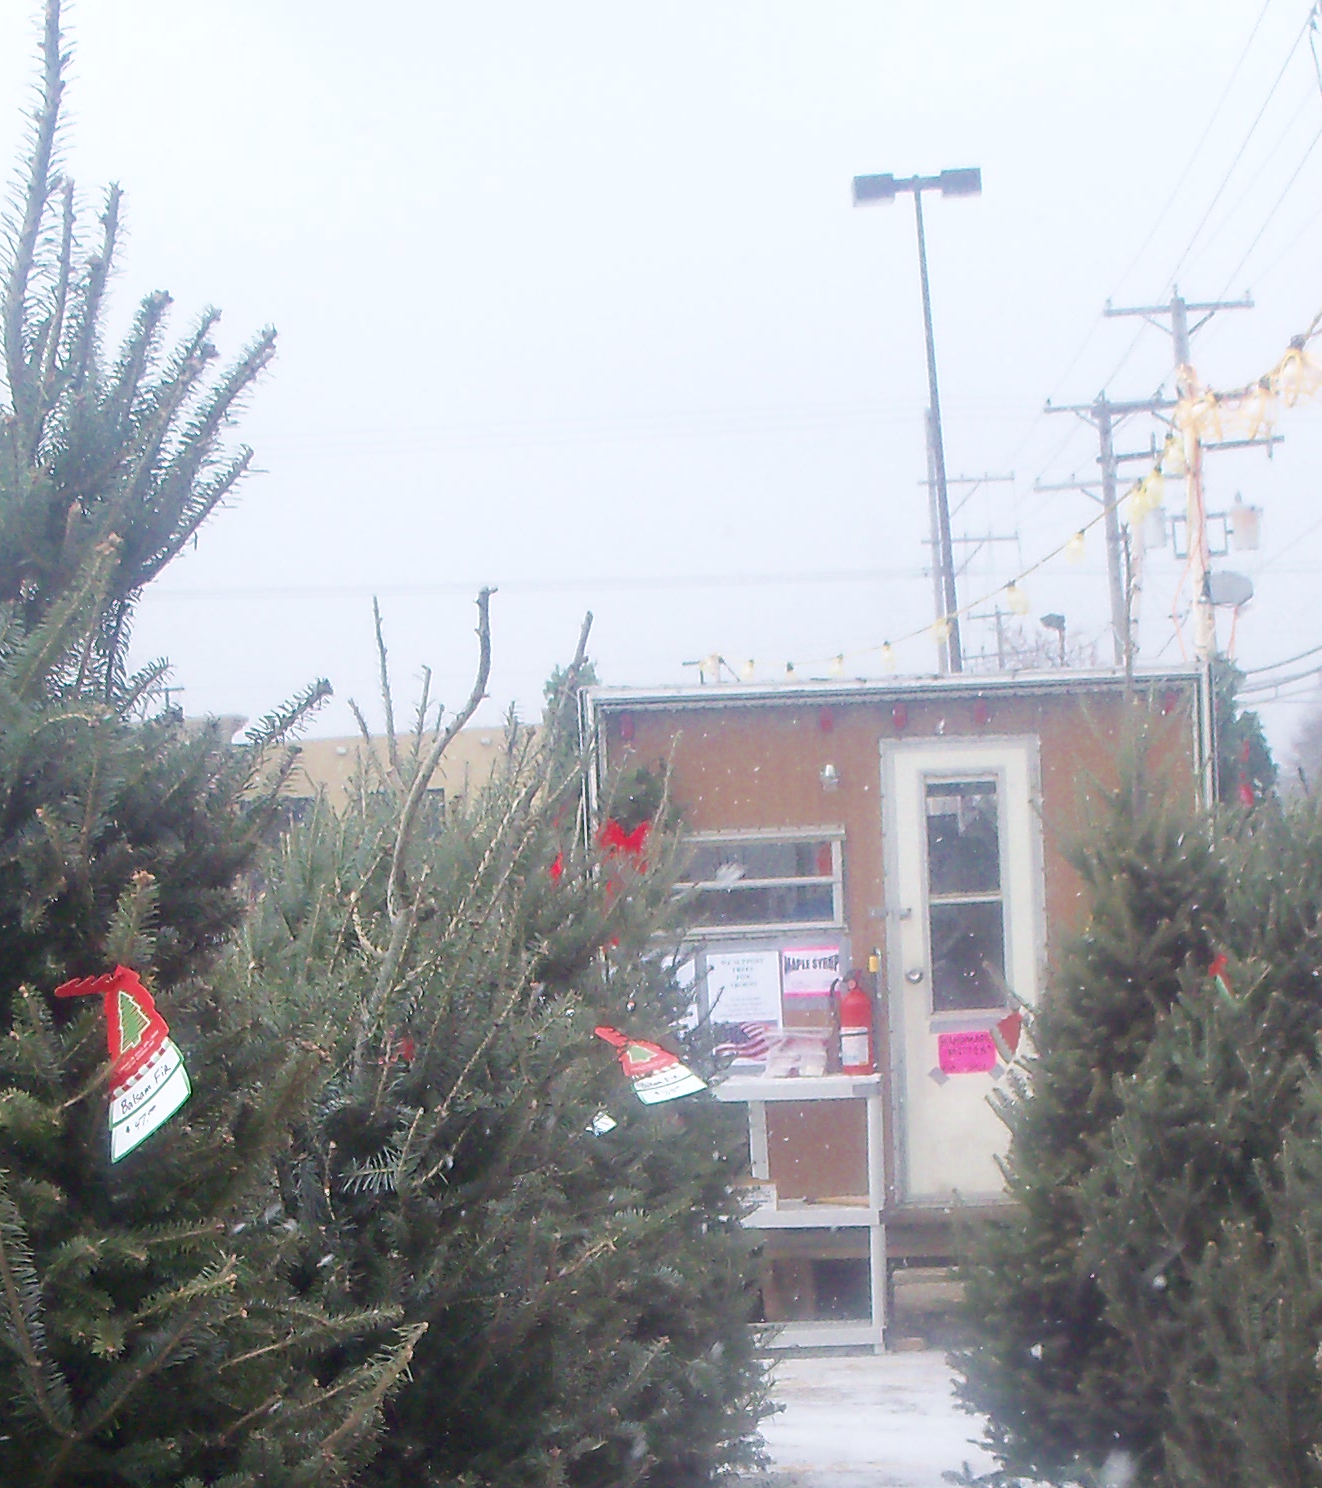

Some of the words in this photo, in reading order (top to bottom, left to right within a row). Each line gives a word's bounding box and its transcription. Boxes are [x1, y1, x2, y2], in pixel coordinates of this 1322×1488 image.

[784, 956, 810, 973] MAPLE
[812, 955, 839, 971] SYRUP
[120, 1085, 152, 1114] Balsam
